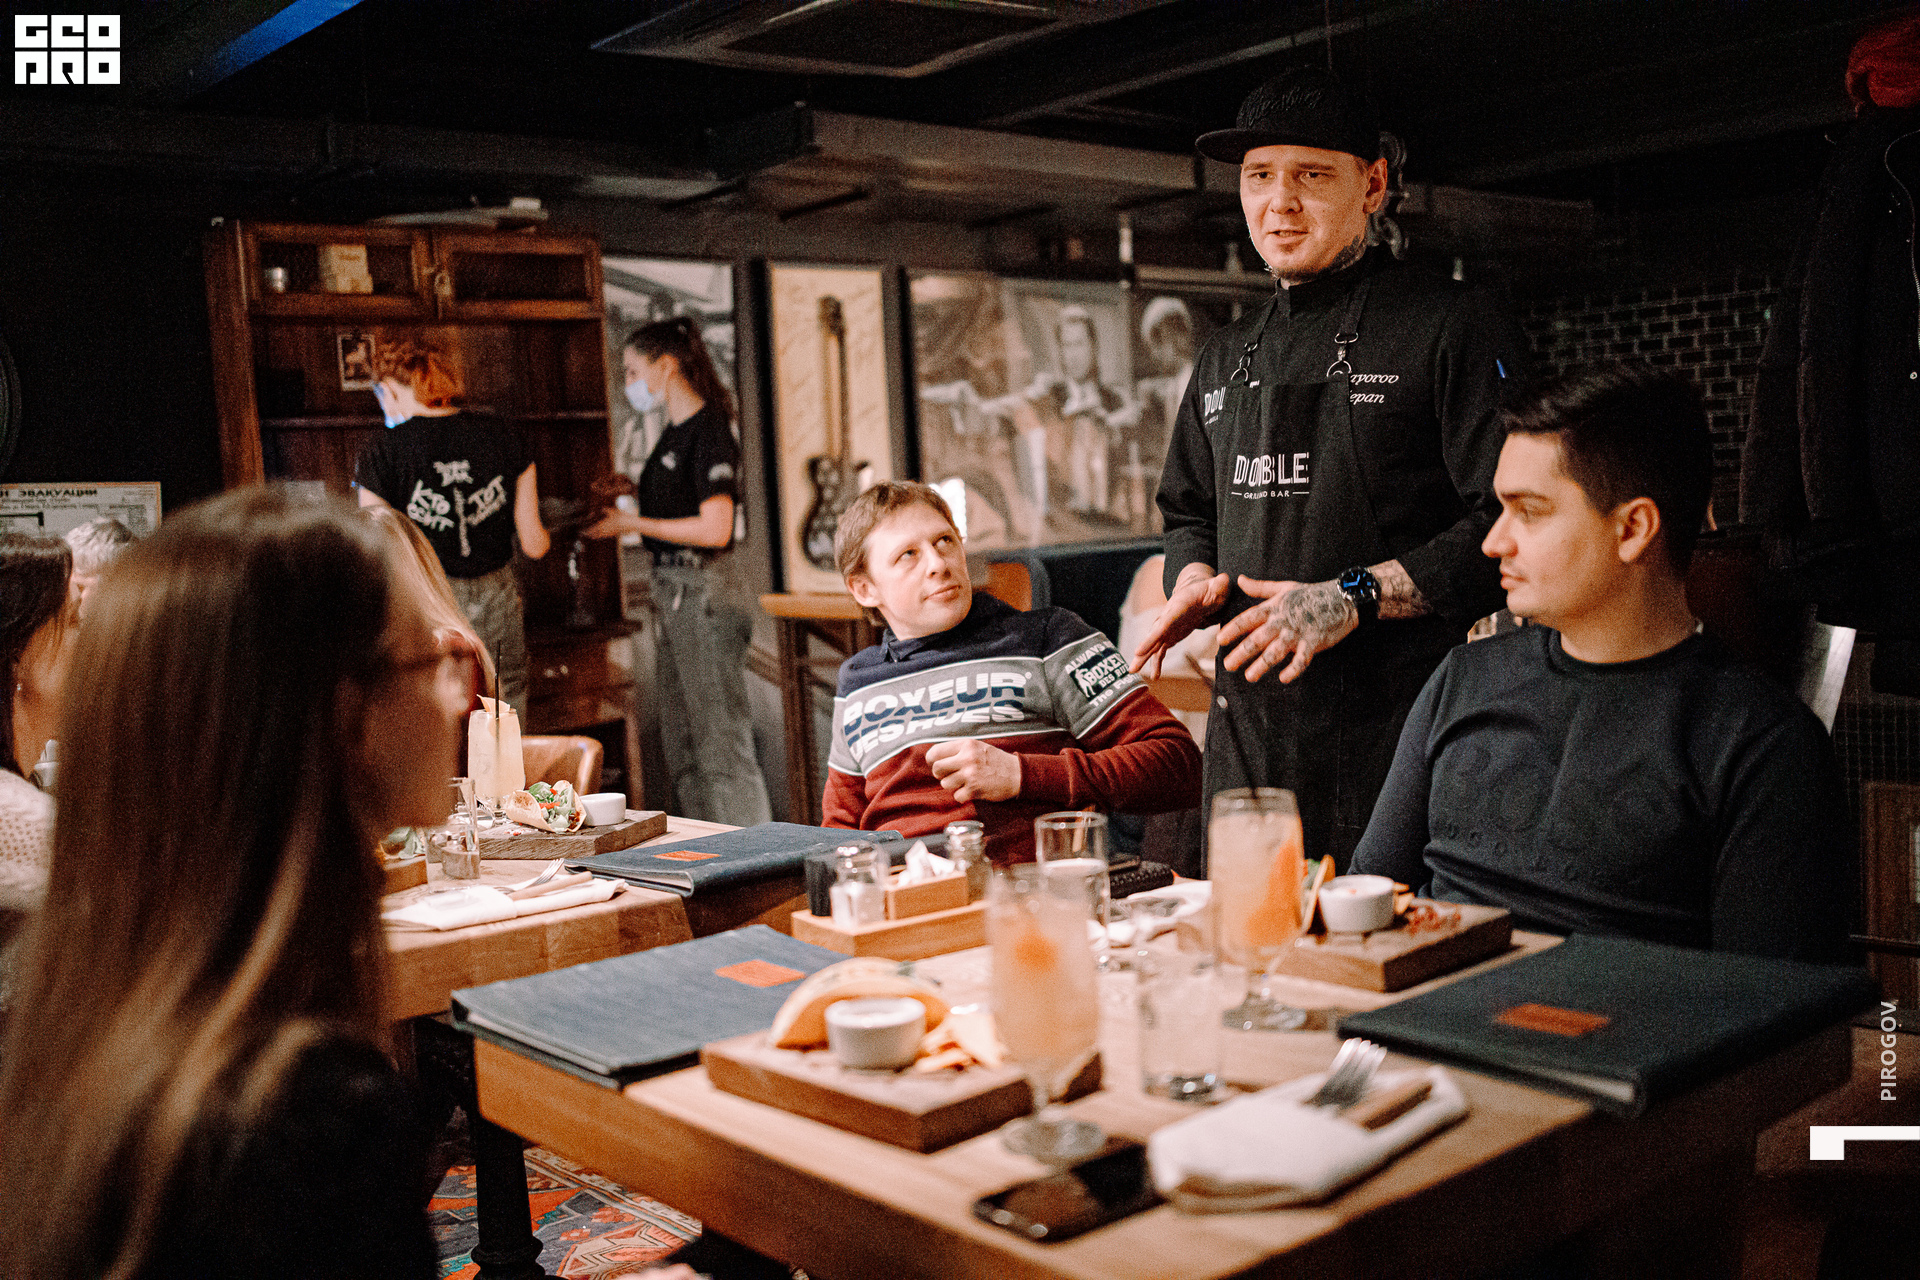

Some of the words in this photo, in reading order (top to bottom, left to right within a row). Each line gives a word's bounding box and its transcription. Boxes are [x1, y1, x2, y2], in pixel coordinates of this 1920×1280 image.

[1204, 387, 1226, 417] DOU
[1350, 393, 1385, 405] epan
[1271, 490, 1290, 498] BAR
[1065, 643, 1106, 675] ALWAYS
[1084, 653, 1126, 686] BOXE
